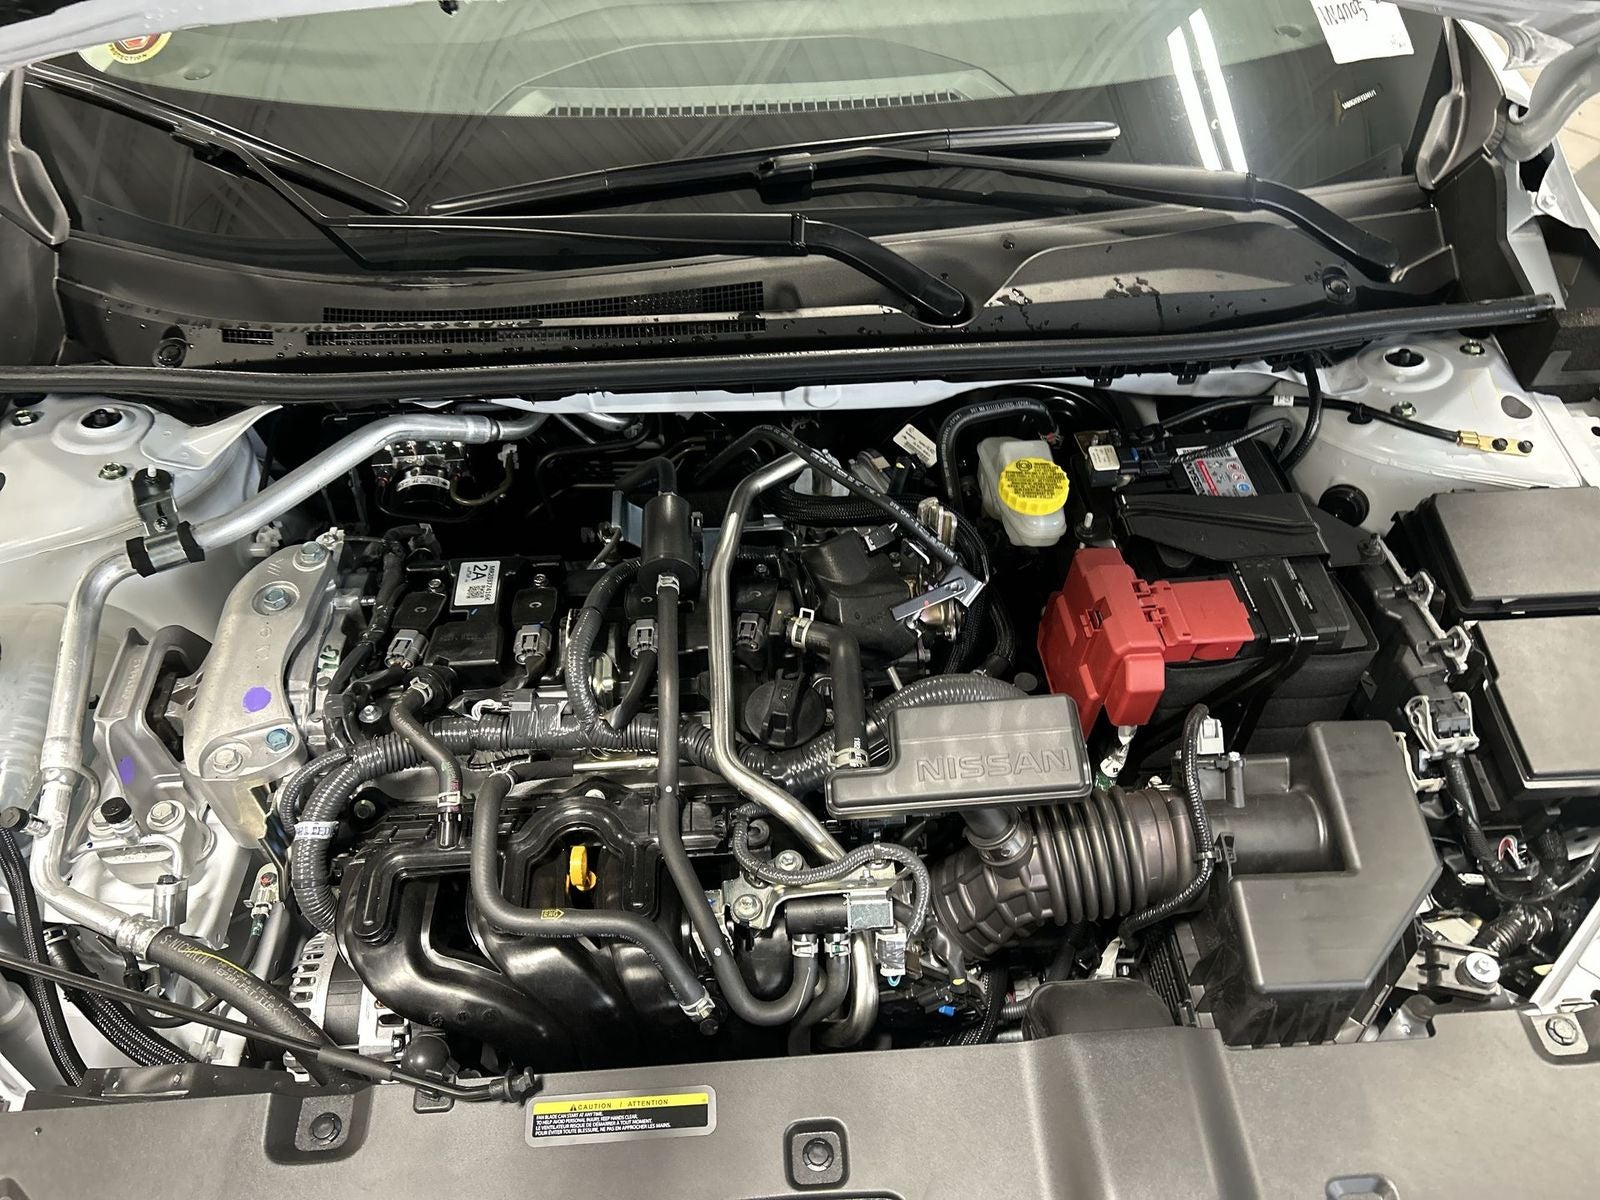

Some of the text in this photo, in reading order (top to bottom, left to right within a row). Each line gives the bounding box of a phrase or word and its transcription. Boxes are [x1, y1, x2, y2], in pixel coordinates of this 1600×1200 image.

[472, 564, 488, 581] 2A
[916, 749, 1072, 782] NISSAN
[577, 1102, 611, 1110] CAUTION
[627, 1098, 668, 1107] ATTENTION
